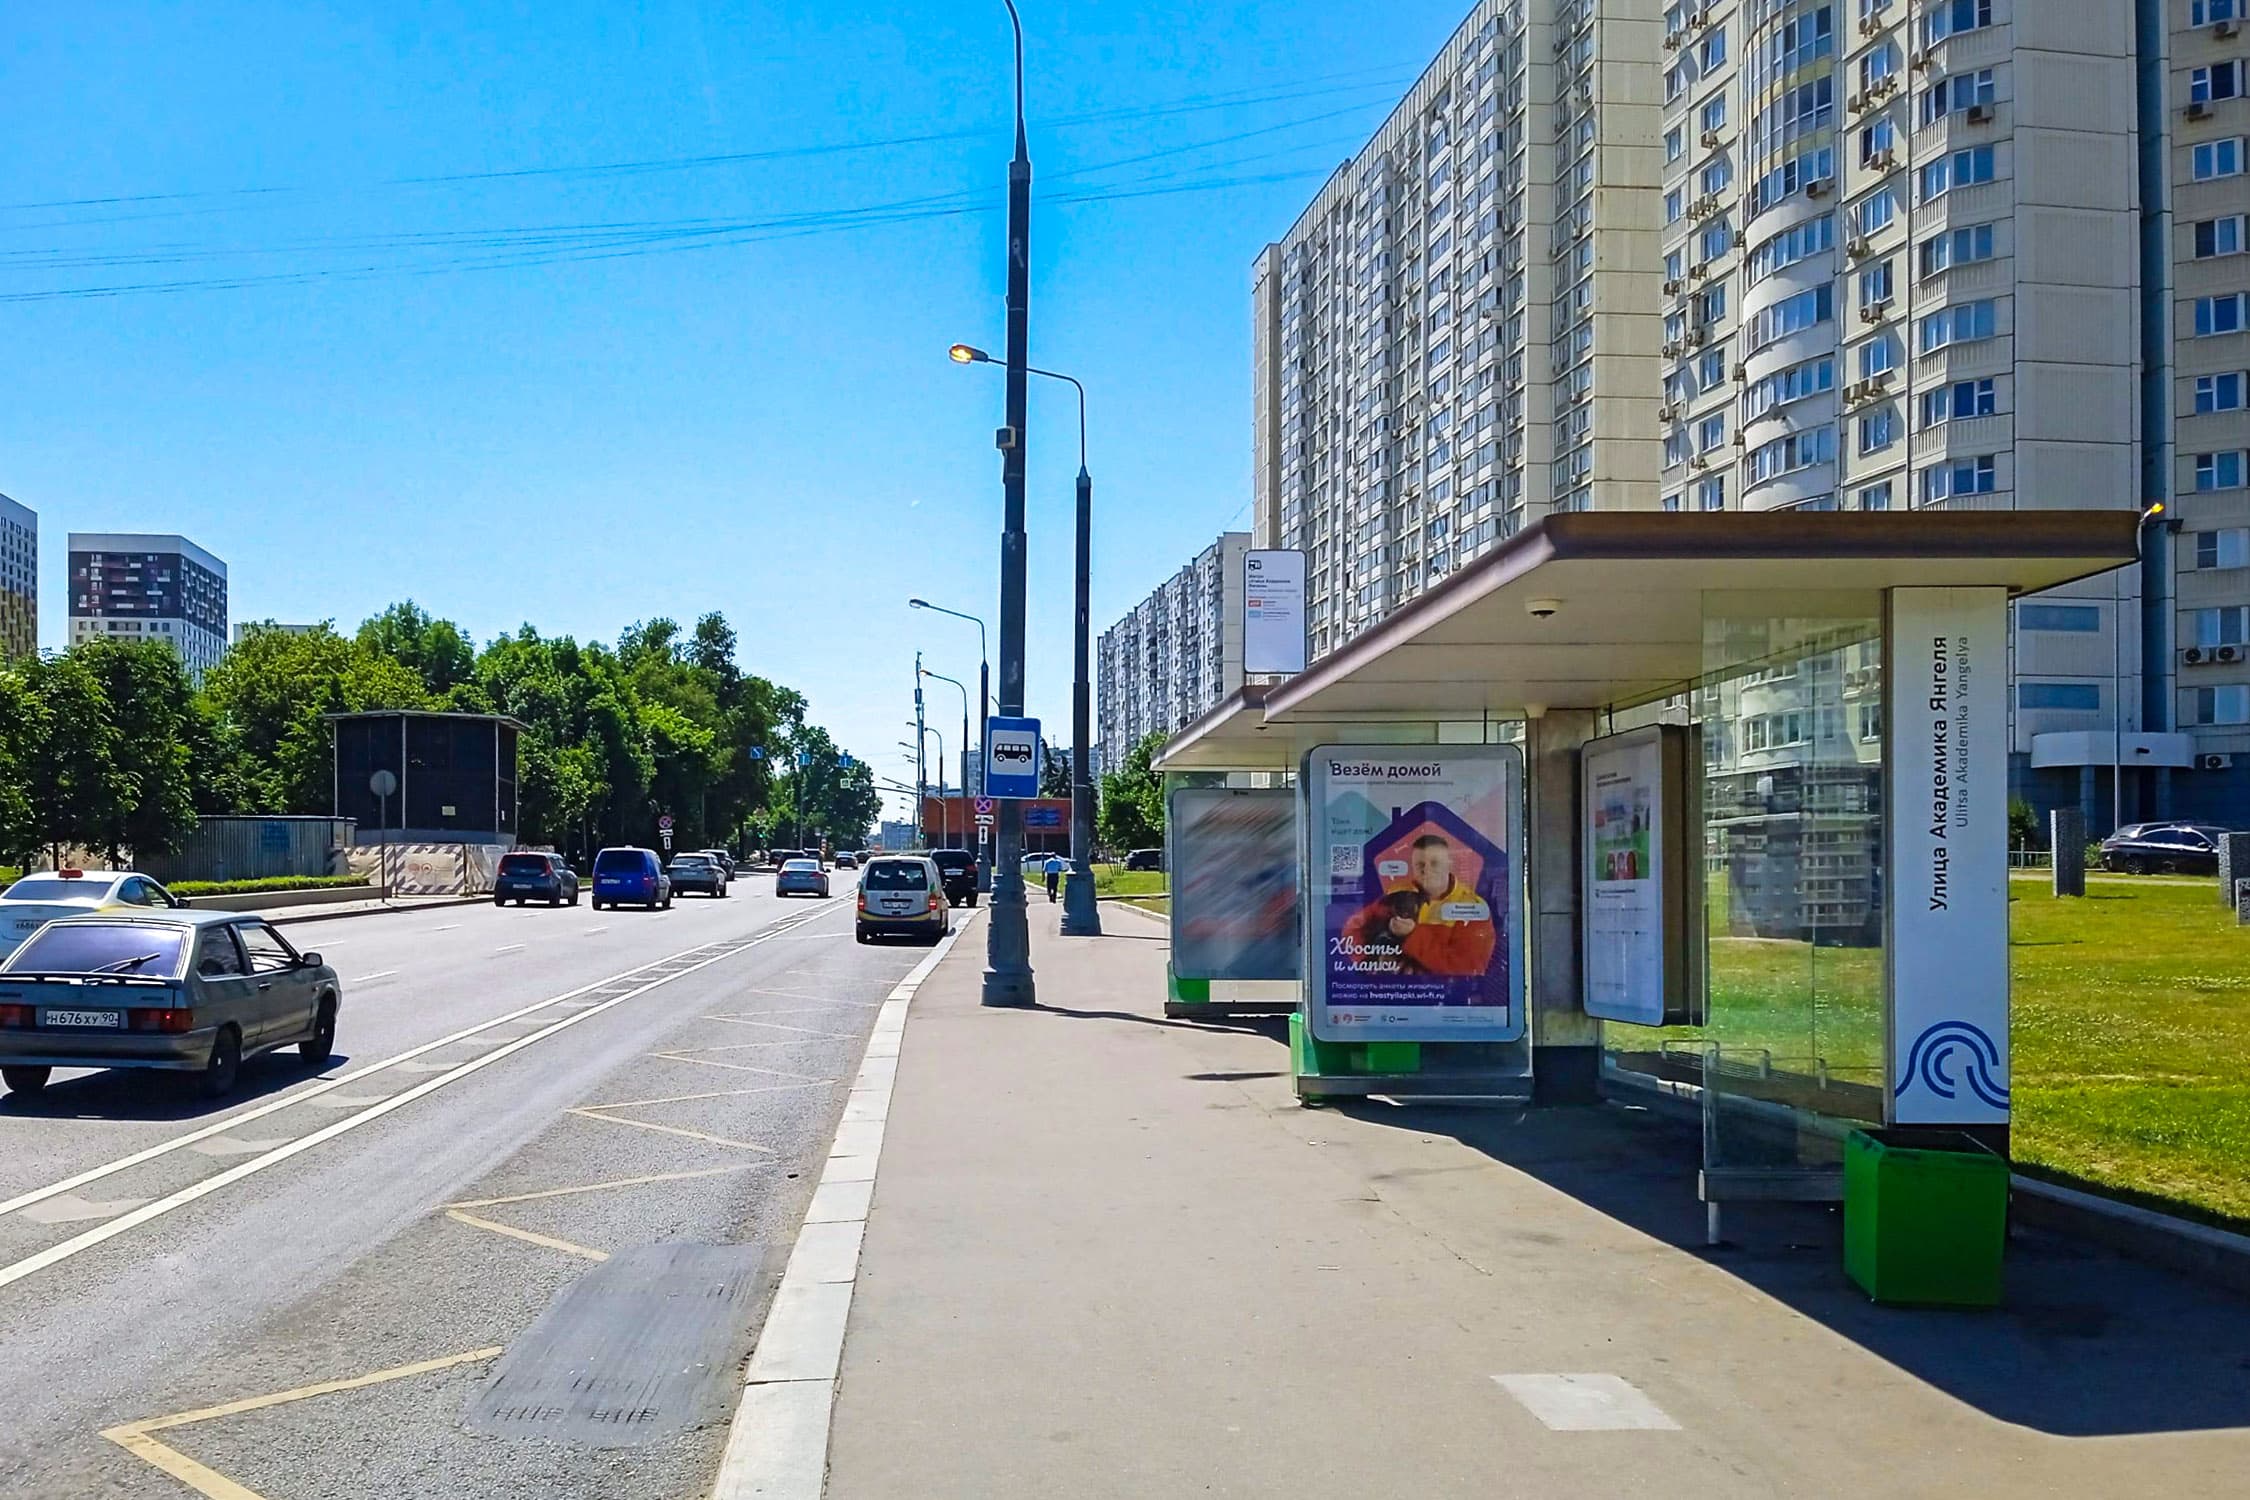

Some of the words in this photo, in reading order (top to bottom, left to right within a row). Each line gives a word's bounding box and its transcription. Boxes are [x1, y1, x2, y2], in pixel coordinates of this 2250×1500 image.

[1929, 637, 1947, 712] Янгеля
[1955, 636, 1971, 700] Yangelya
[1331, 763, 1384, 777] Везём
[1387, 763, 1441, 778] домой
[1955, 704, 1969, 783] Akademika
[1929, 719, 1950, 839] Академика
[1955, 788, 1969, 828] Ulitsa
[1929, 847, 1950, 911] Улица
[1330, 935, 1403, 955] Хвосты
[1334, 961, 1346, 971] и
[1347, 960, 1401, 972] лапки
